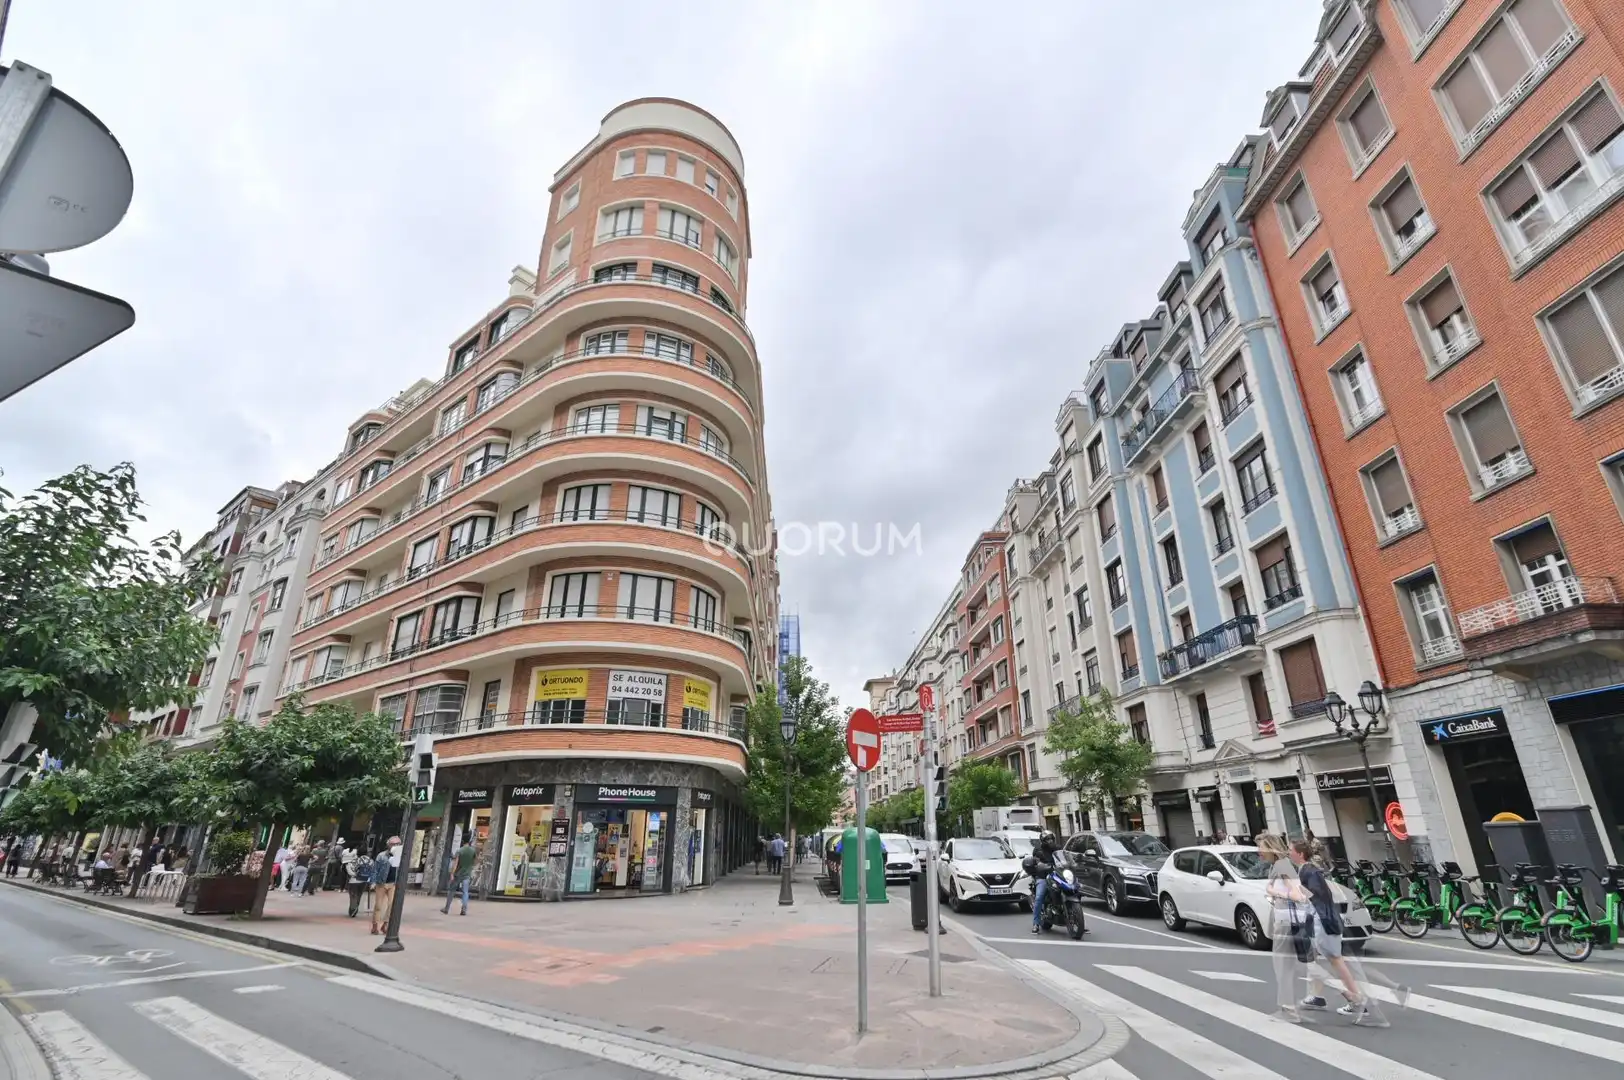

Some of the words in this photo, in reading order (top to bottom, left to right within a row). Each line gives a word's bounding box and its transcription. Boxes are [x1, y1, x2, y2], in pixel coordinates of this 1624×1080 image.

[613, 674, 624, 682] SE
[627, 675, 663, 686] ALQUILA
[611, 685, 622, 693] 94
[624, 686, 640, 695] 442
[641, 687, 652, 695] 20
[653, 688, 663, 697] 58
[1447, 716, 1497, 734] CaixaBank
